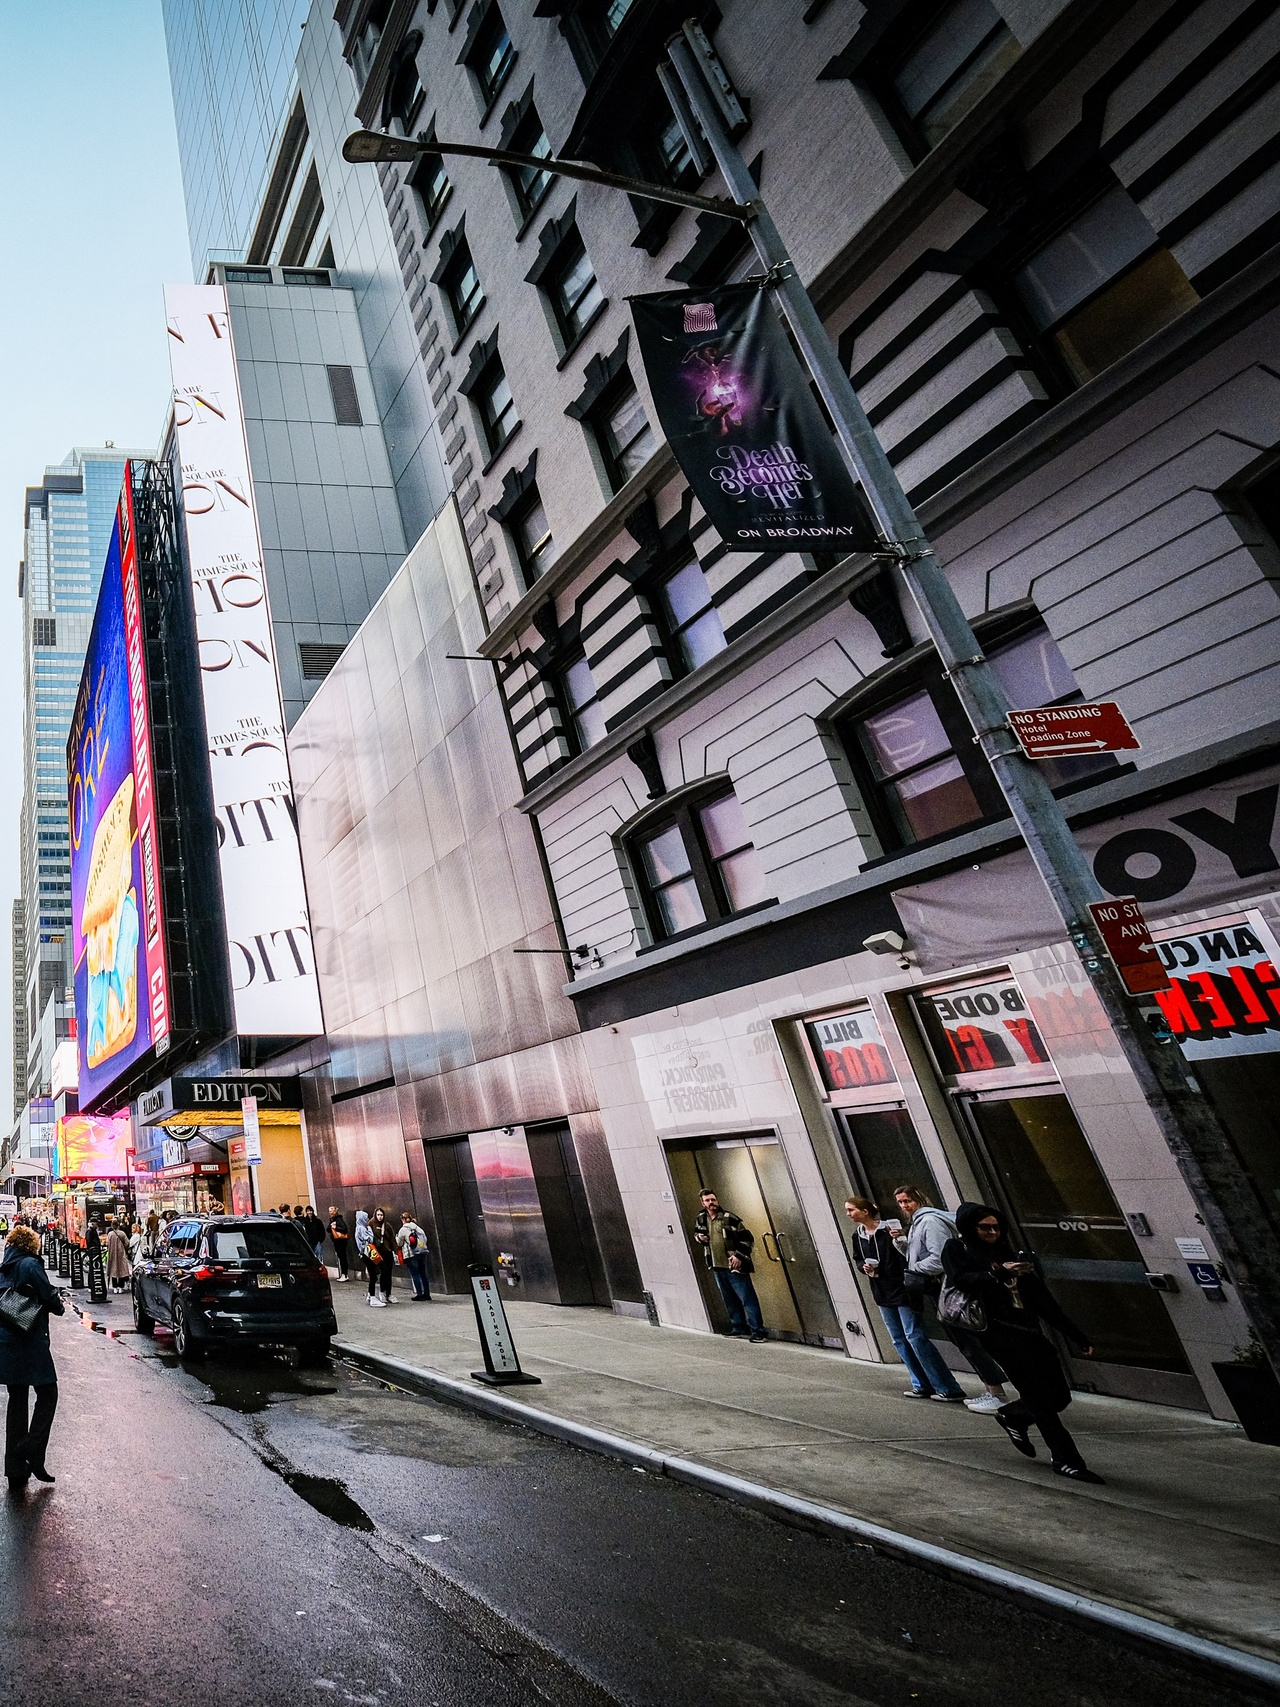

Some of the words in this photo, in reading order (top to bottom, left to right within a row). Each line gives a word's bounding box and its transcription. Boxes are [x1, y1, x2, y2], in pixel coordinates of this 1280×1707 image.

[716, 440, 799, 470] Death
[185, 468, 227, 482] SQUARE
[709, 461, 814, 497] Becomes
[751, 481, 805, 510] Her
[751, 513, 825, 524] REVITALIZED
[737, 529, 762, 538] ON
[768, 525, 854, 538] BROADWAY
[218, 552, 243, 564] THE
[194, 564, 230, 578] TIMES
[236, 716, 263, 729] THE
[1014, 711, 1035, 726] NO
[1036, 706, 1102, 724] STANDING
[1020, 723, 1049, 735] Hotel
[1024, 731, 1065, 744] Loading
[1066, 728, 1091, 739] Zone
[210, 730, 249, 746] TIMES
[1097, 906, 1119, 923] NO
[1121, 922, 1149, 939] ANY
[191, 1082, 282, 1103] EDITION
[1058, 1220, 1089, 1232] OYO
[485, 1292, 500, 1337] LOADING
[496, 1342, 507, 1367] ZONE
